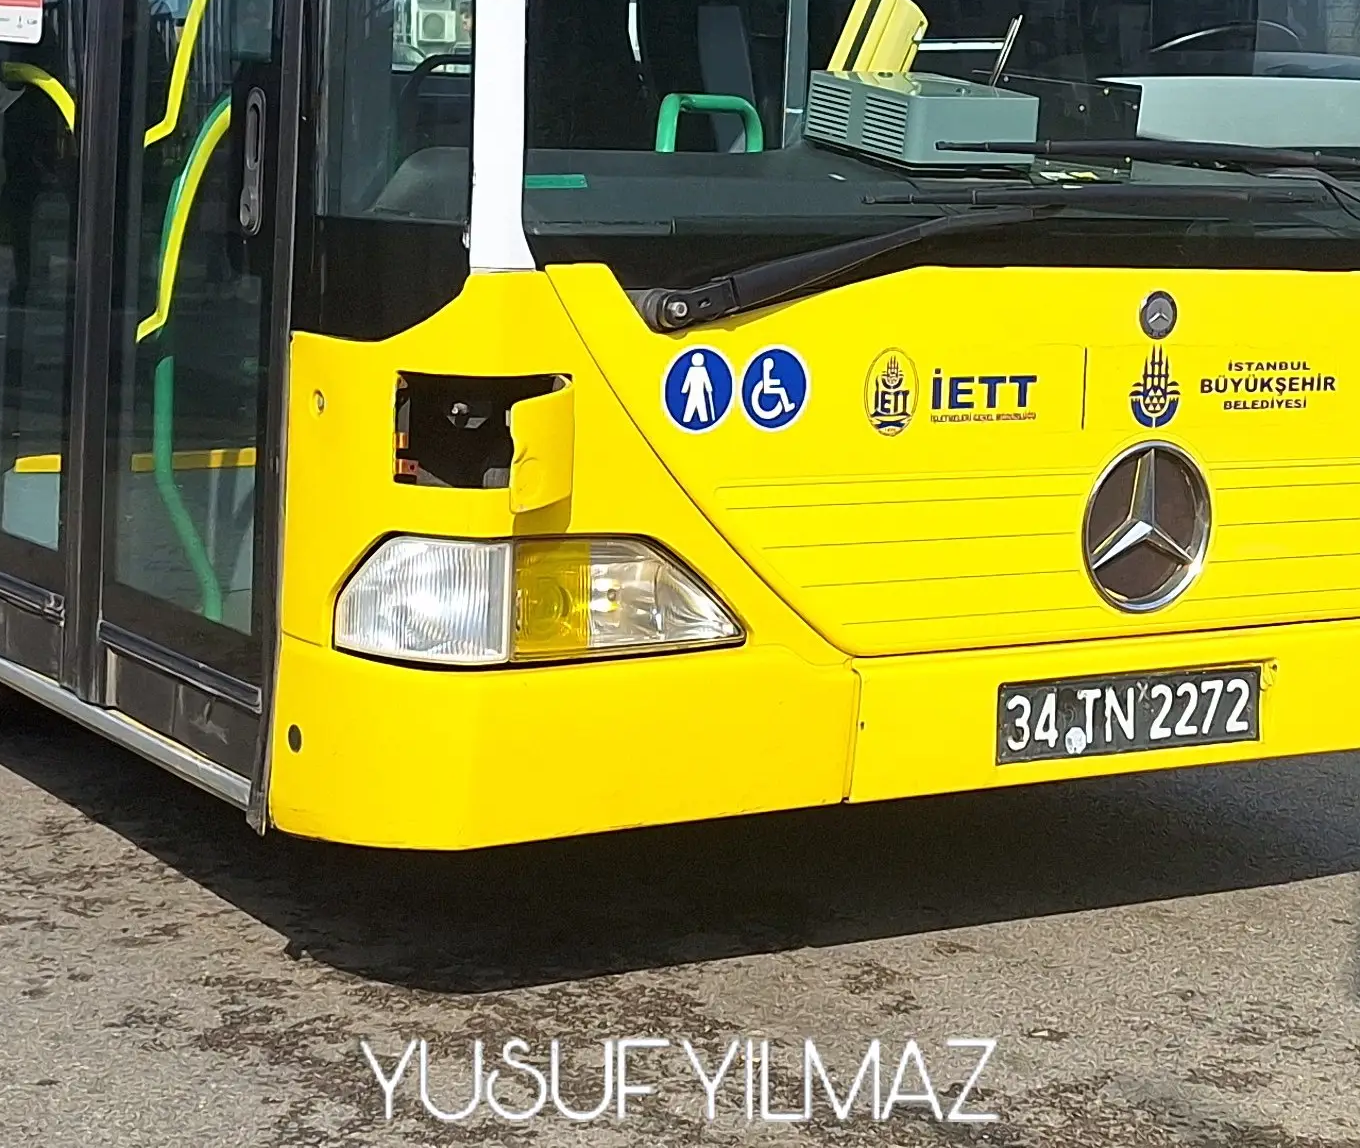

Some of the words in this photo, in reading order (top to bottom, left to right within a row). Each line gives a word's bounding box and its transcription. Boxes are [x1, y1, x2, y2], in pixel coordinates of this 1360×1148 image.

[1228, 360, 1311, 372] İSTANBUL
[931, 368, 1038, 410] İETT
[1200, 373, 1336, 396] BÜYÜKŞEHİR
[1223, 396, 1307, 410] BELEDİYESİ
[1006, 692, 1058, 751] 34
[1077, 687, 1135, 743] TN
[1149, 678, 1251, 740] 2272
